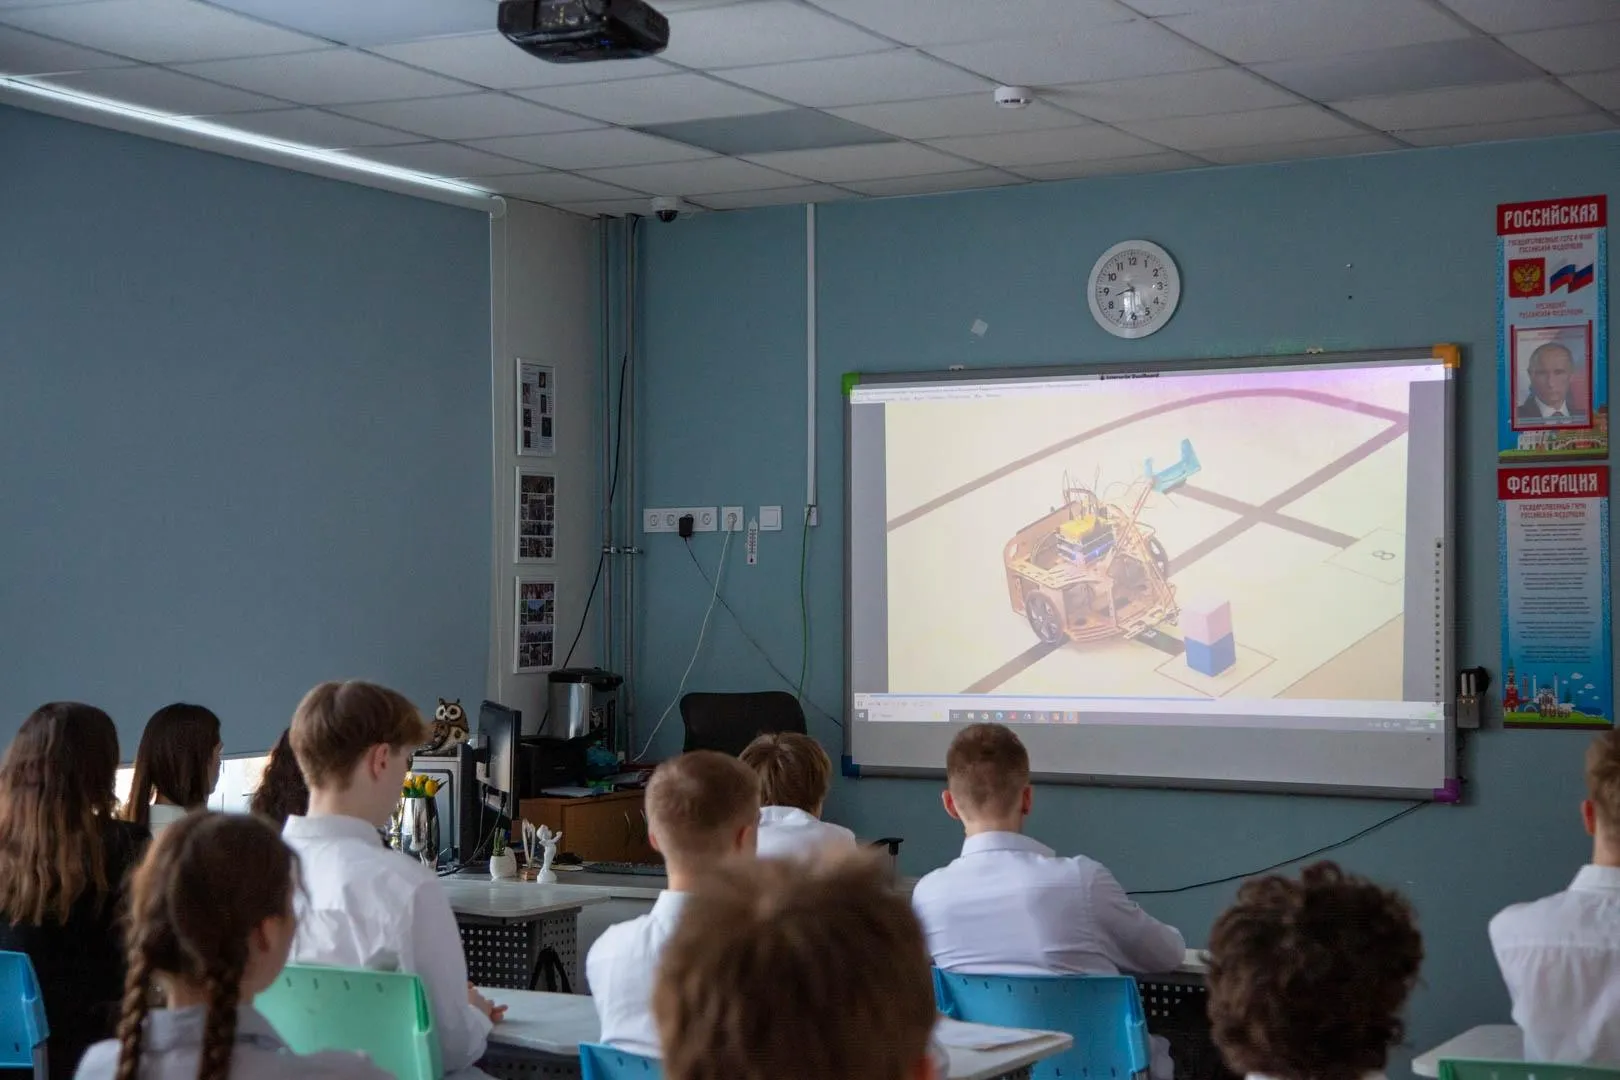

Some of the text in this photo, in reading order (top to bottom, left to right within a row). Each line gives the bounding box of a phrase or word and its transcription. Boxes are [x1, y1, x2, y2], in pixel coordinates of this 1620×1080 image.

[1503, 203, 1598, 230] РОССИЙСКАЯ
[1128, 257, 1137, 266] 12
[1116, 262, 1124, 271] 11
[1107, 272, 1117, 282] 10
[1152, 268, 1159, 278] 2
[1157, 281, 1163, 290] 3
[1103, 287, 1110, 296] 9
[1108, 301, 1114, 309] 8
[1153, 296, 1160, 305] 4
[1119, 310, 1125, 318] 7
[1145, 307, 1150, 316] 5
[1131, 313, 1137, 321] 6
[1506, 472, 1598, 496] ФЕДЕРАЦИЯ
